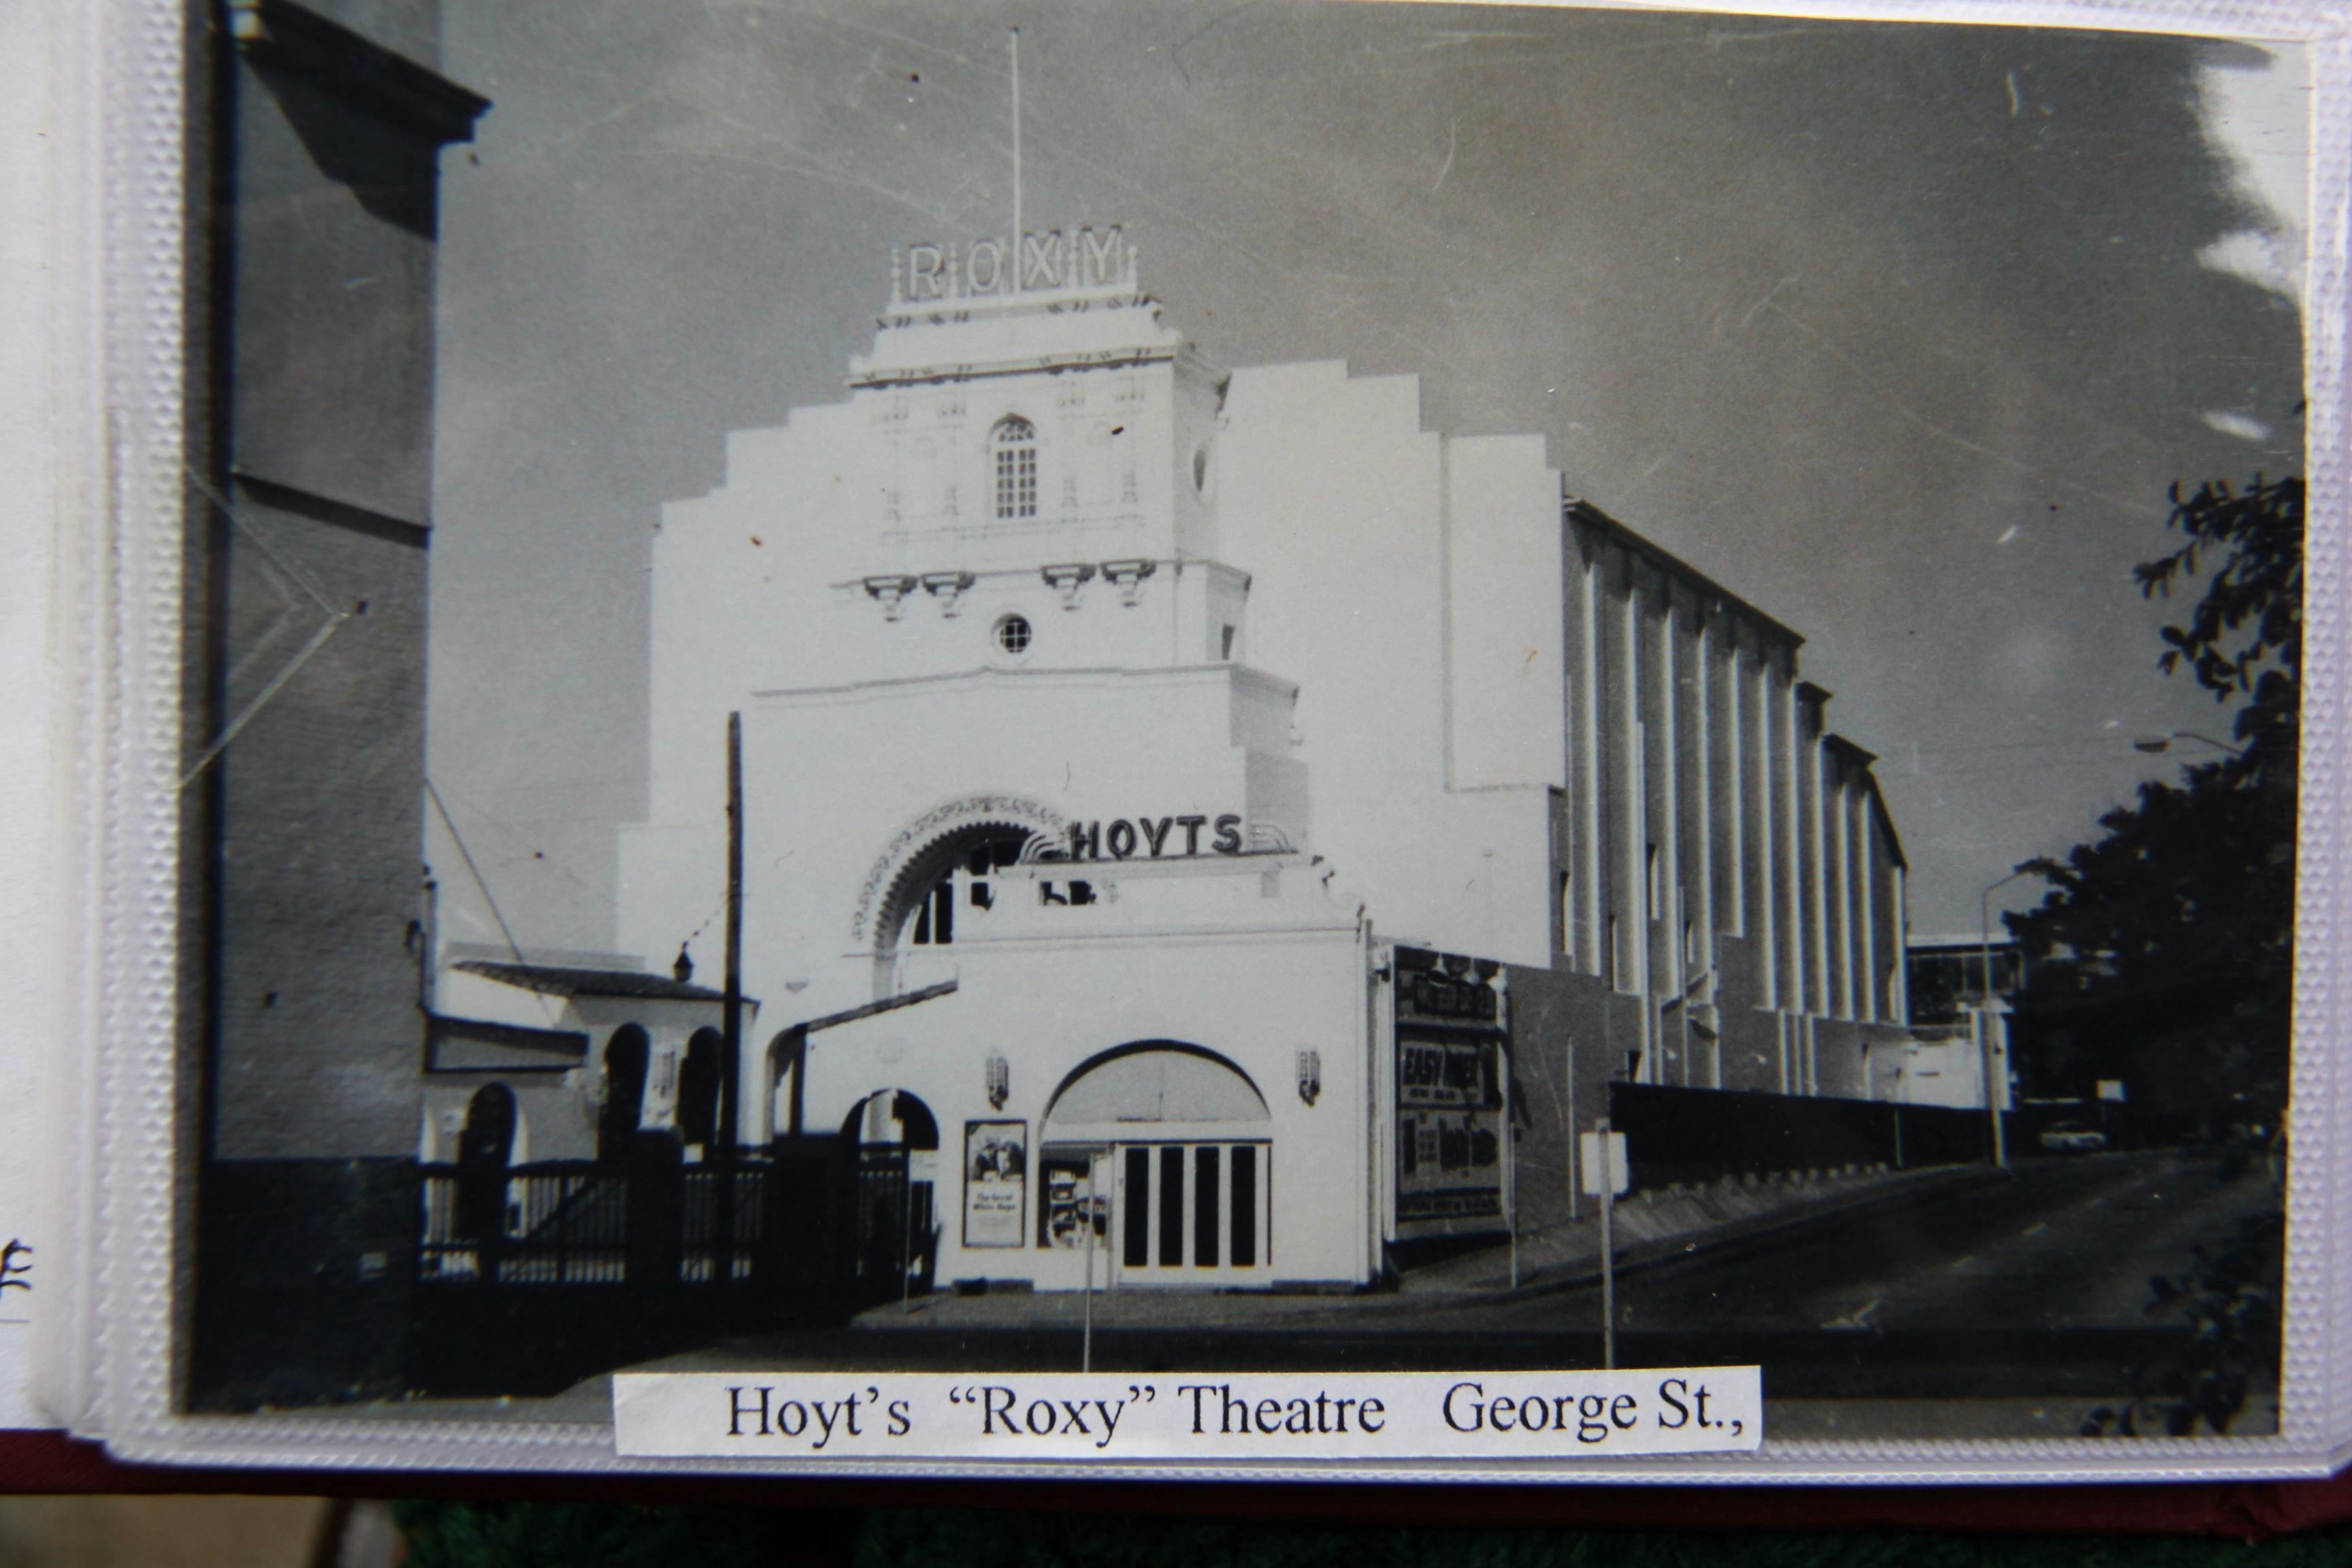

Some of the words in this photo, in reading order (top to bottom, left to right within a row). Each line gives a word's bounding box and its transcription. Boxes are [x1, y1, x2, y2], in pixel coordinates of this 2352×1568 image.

[906, 223, 1123, 301] ROXY
[1070, 813, 1243, 860] HOYTS
[1403, 1047, 1444, 1085] EASY
[729, 1387, 910, 1448] Hoyt’s
[950, 1386, 1155, 1448] “Roxy”
[1178, 1385, 1384, 1433] Theatre
[1443, 1383, 1636, 1443] George
[1659, 1379, 1742, 1435] St.,
